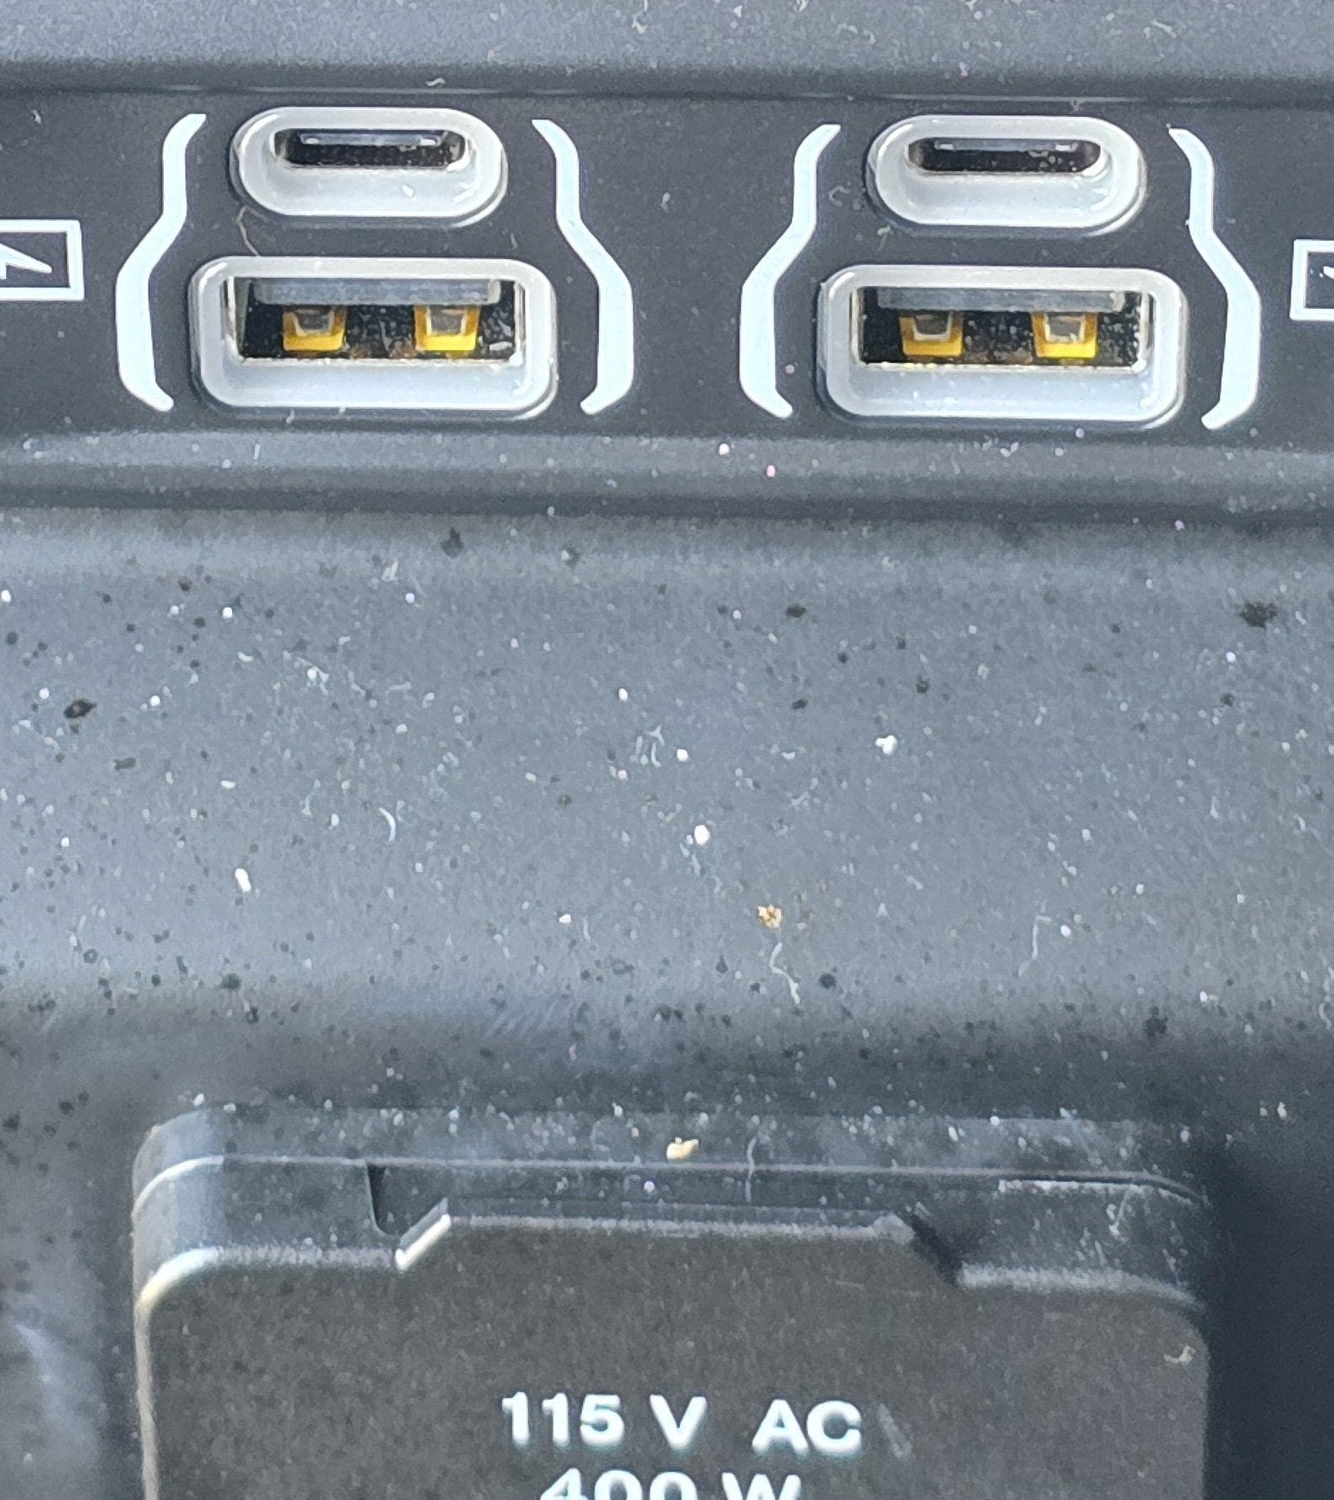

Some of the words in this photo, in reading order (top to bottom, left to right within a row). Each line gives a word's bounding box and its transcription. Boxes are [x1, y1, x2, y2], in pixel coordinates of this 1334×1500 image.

[501, 1391, 626, 1451] 115
[649, 1394, 708, 1453] V
[751, 1398, 863, 1459] AC
